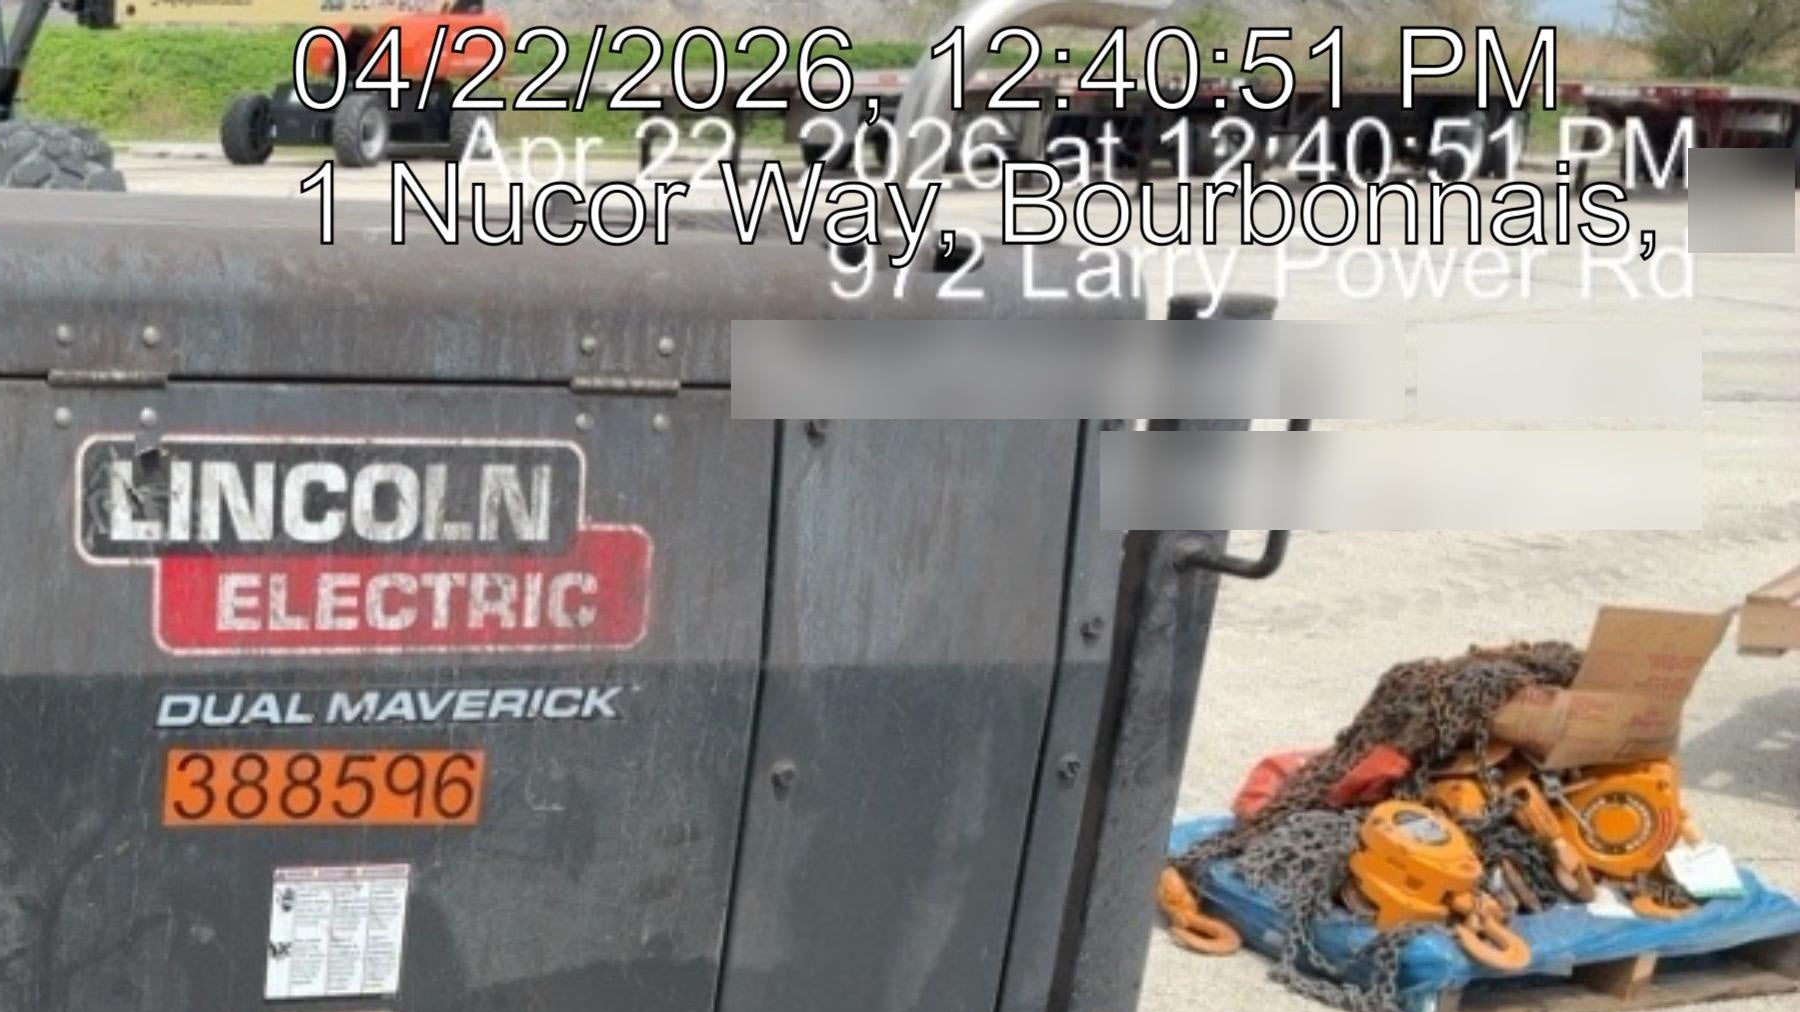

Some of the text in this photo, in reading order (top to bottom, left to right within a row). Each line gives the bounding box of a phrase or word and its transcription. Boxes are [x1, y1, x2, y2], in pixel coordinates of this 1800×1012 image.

[109, 460, 551, 543] LINCOLN
[215, 570, 599, 633] ELECTRIC
[155, 686, 625, 728] DUAL MAVERICK
[172, 752, 477, 821] 388596
